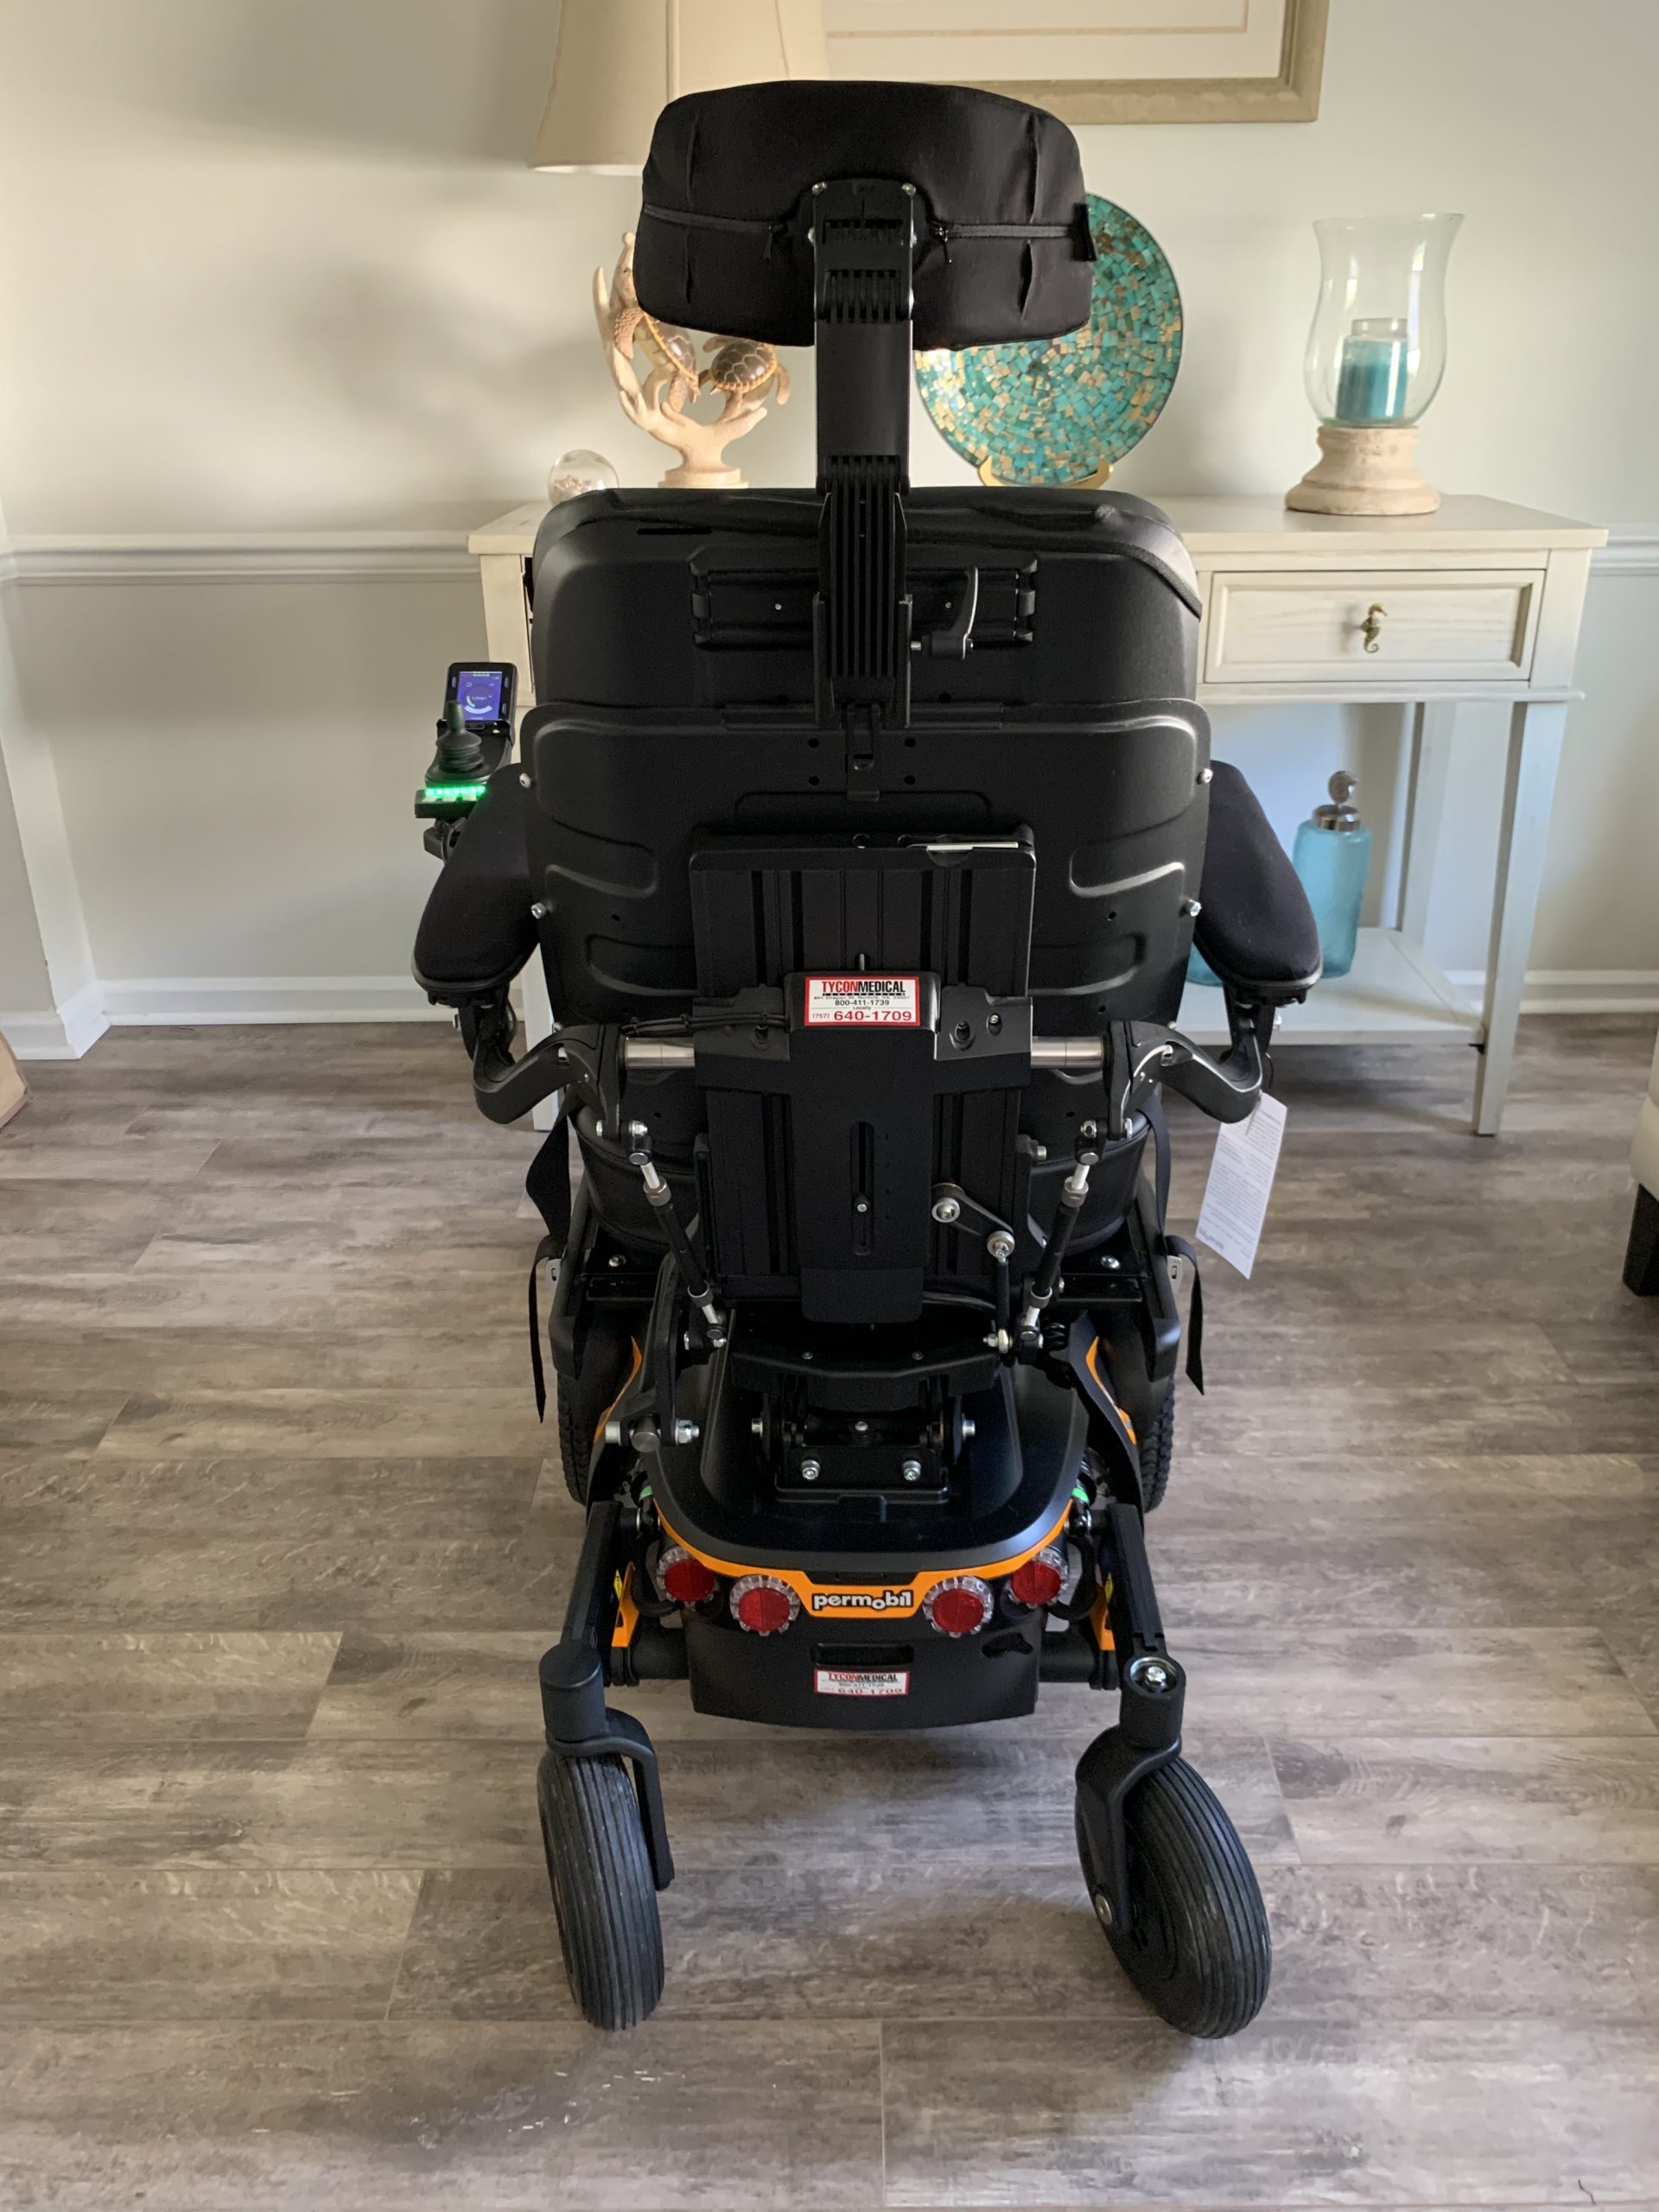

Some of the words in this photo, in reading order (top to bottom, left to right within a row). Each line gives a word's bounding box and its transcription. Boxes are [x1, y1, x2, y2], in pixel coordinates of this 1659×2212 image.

[822, 981, 906, 993] TYCONMEDICAL
[834, 1011, 912, 1020] 640-1709
[813, 1591, 912, 1610] permobil
